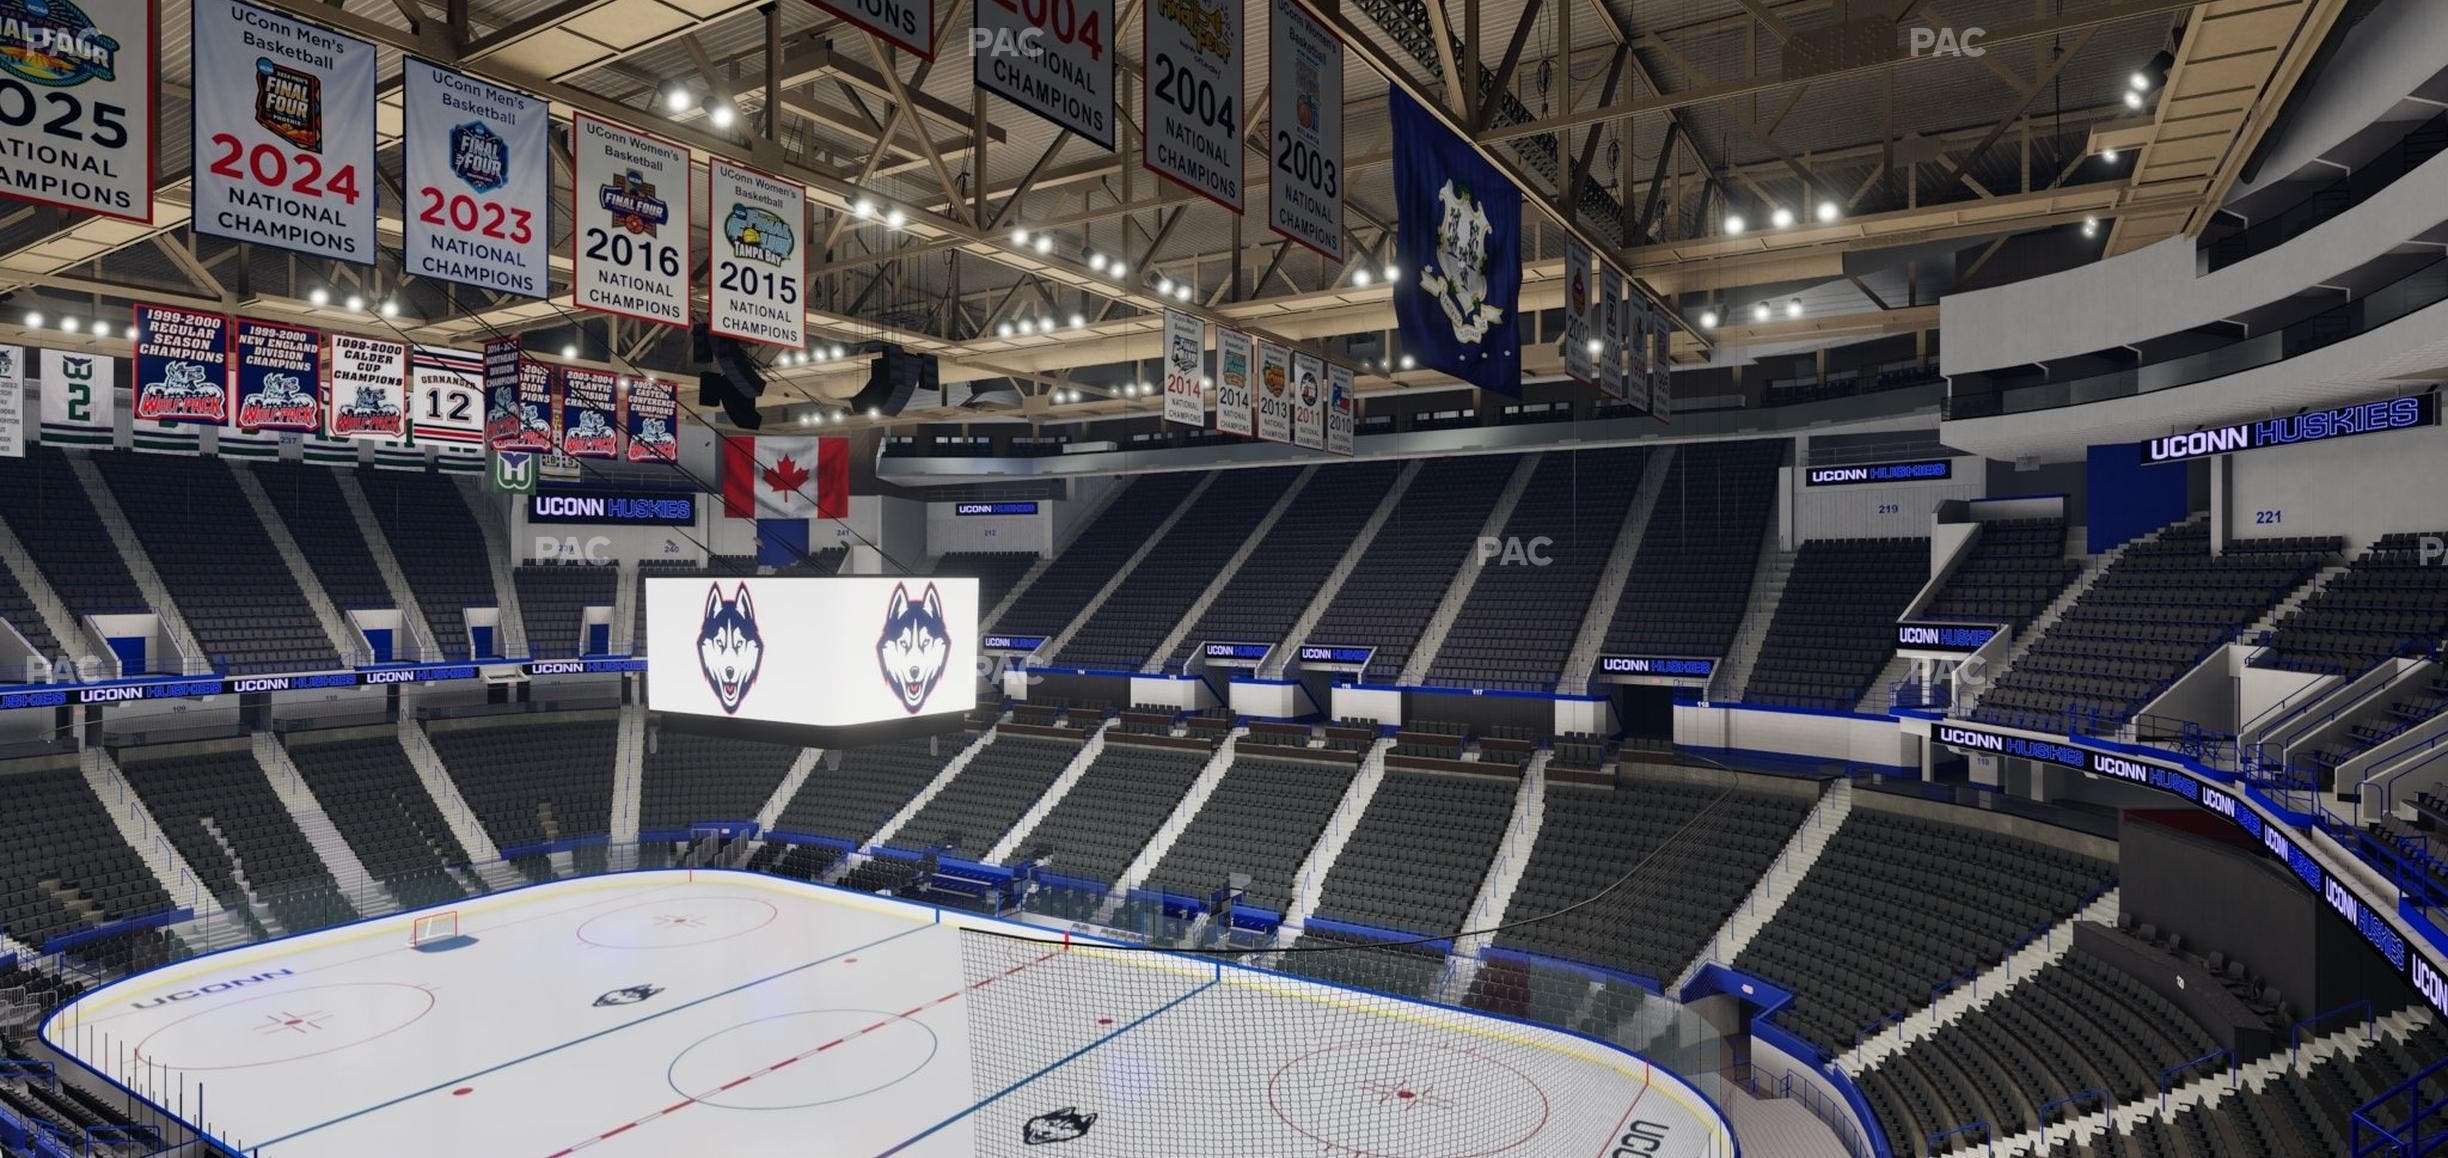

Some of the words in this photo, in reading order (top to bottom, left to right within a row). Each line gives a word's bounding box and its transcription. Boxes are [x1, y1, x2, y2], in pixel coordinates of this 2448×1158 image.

[231, 6, 290, 37] UConn
[297, 28, 345, 54] Men's
[243, 31, 334, 70] Basketball
[1006, 25, 1096, 95] NATIONAL
[265, 76, 309, 102] FINAL
[432, 70, 481, 97] UConn
[486, 88, 525, 110] Men's
[993, 59, 1103, 132] CHAMPIONS
[1155, 53, 1236, 139] 2004
[265, 92, 309, 119] FOUR
[442, 93, 516, 125] Basketball
[461, 135, 500, 160] FINAL
[586, 123, 626, 144] UConn
[629, 137, 680, 161] Women's
[1166, 117, 1230, 168] NATIONAL
[210, 133, 360, 205] 2024
[464, 153, 502, 177] FOUR
[605, 145, 663, 171] Basketball
[1278, 130, 1337, 199] 2003
[720, 166, 753, 185] UConn
[755, 178, 797, 199] Women's
[1158, 144, 1236, 199] CHAMPIONS
[229, 187, 347, 227] NATIONAL
[605, 193, 635, 210] FINAL
[636, 201, 664, 218] FOUR
[735, 186, 784, 209] Basketball
[1285, 183, 1334, 225] NATIONAL
[420, 187, 532, 244] 2023
[218, 212, 356, 253] CHAMPIONS
[1280, 208, 1338, 250] CHAMPIONS
[431, 234, 526, 268] NATIONAL
[586, 228, 679, 277] 2016
[734, 241, 764, 260] TAMPA
[764, 248, 782, 265] BAY
[422, 257, 533, 291] CHAMPIONS
[599, 270, 674, 297] NATIONAL
[720, 262, 797, 304] 2015
[589, 289, 681, 318] CHAMPIONS
[730, 299, 792, 323] NATIONAL
[147, 309, 221, 329] 1999-2000
[149, 321, 216, 339] REGULAR
[722, 317, 798, 342] CHAMPIONS
[153, 334, 211, 350] SEASON
[238, 334, 266, 345] NEW
[267, 337, 318, 354] ENGLAND
[249, 325, 307, 342] 1999-2000
[139, 343, 225, 364] CHAMPIONS
[254, 346, 304, 361] DIVISION
[336, 337, 403, 356] 1999-2000
[344, 350, 394, 365] CALDER
[245, 355, 312, 372] CHAMPIONS
[357, 362, 381, 373] CUP
[334, 370, 403, 387] CHAMPIONS
[566, 371, 614, 385] 2003-2004
[568, 380, 612, 394] ATLANTIC
[1168, 374, 1201, 398] 2014
[426, 387, 472, 423] 12
[521, 392, 551, 404] PIONS
[628, 395, 676, 408] CONFERENCE
[630, 404, 674, 416] CHAMPIONS
[1219, 387, 1249, 409] 2014
[1261, 397, 1287, 418] 2013
[1297, 406, 1320, 425] 2011
[1329, 415, 1352, 433] 2010
[2150, 425, 2248, 461] UCONN
[2256, 397, 2419, 447] HUSKIES
[1812, 468, 1868, 483] UCONN
[536, 497, 604, 516] UCONN
[608, 499, 690, 518] HUSKIES
[959, 505, 991, 513] UCONN
[1878, 505, 1898, 514] 219
[2256, 510, 2282, 524] 221
[985, 637, 1010, 647] UCONN
[1900, 627, 1939, 644] UCONN
[1207, 645, 1234, 656] UCONN
[1302, 649, 1331, 660] UCONN
[532, 663, 584, 674] UCONN
[1604, 658, 1649, 671] UCONN
[234, 678, 289, 692] UCONN
[366, 671, 414, 683] UCONN
[80, 687, 143, 702] UCONN
[1940, 728, 2002, 750] UCONN
[2094, 754, 2146, 782] UCONN
[2203, 786, 2235, 817] UCONN
[2325, 875, 2357, 926] UCONN
[130, 968, 294, 1009] UCONN
